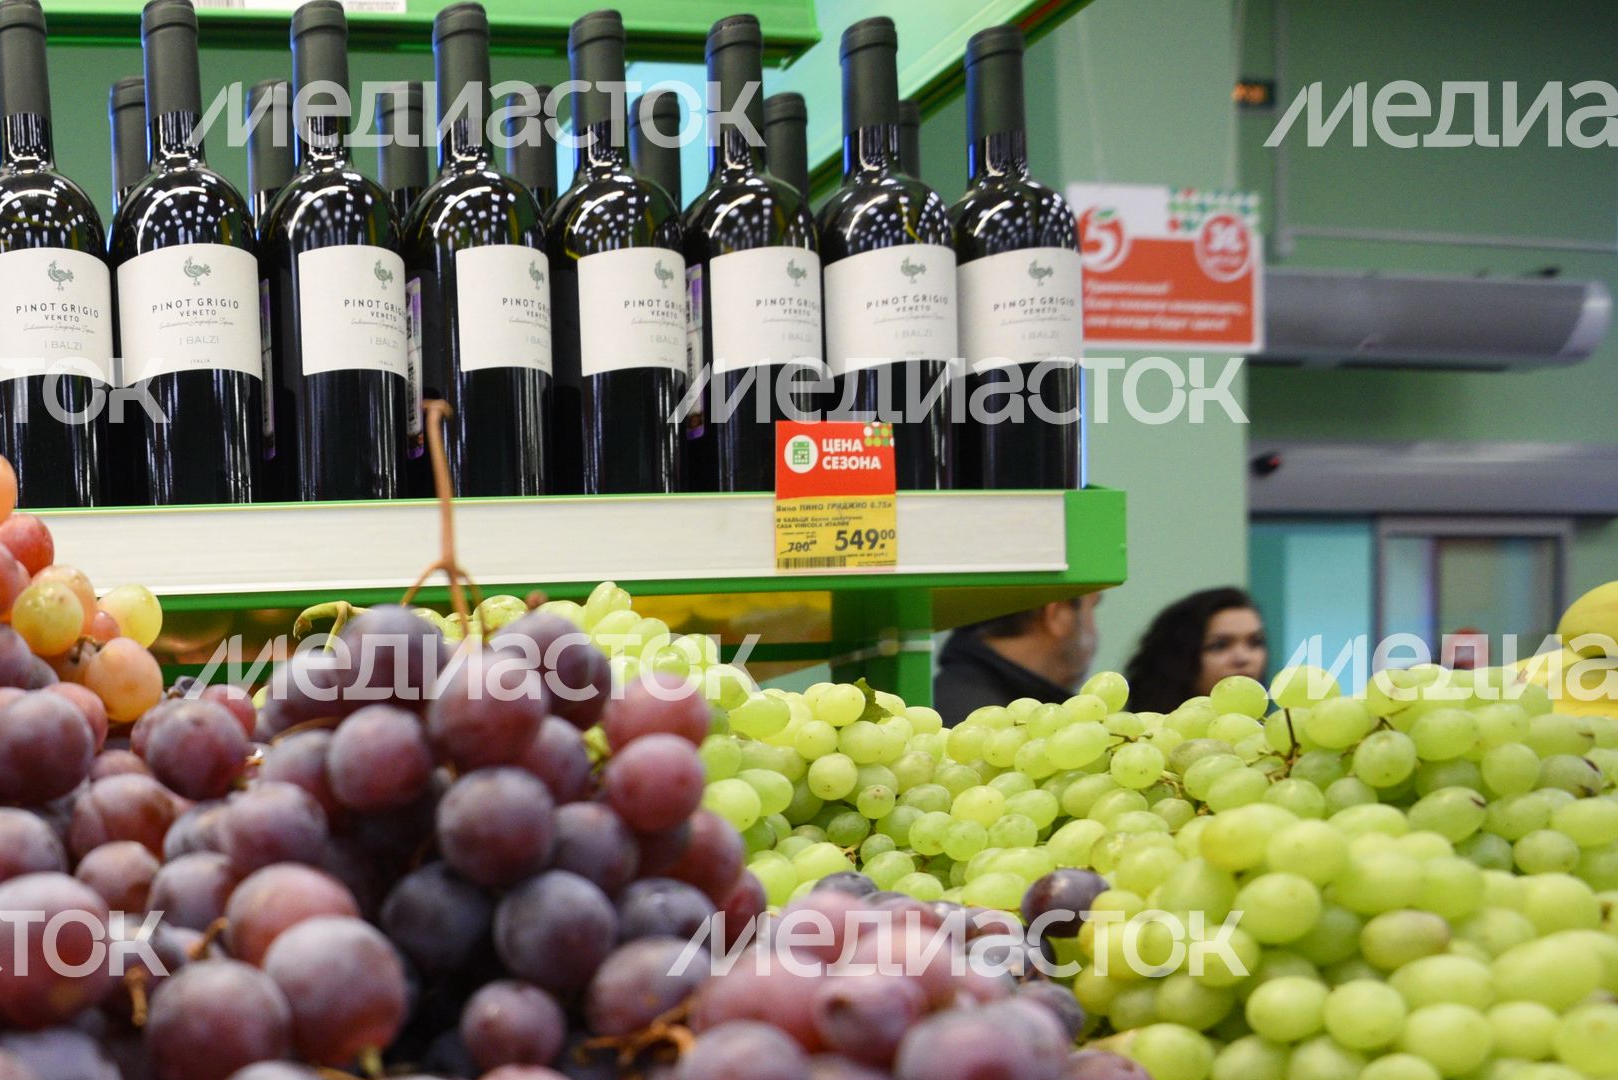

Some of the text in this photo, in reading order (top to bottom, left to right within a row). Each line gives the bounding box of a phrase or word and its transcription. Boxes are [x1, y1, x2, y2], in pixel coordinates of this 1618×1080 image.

[152, 297, 239, 313] PINOT GRIGIO
[344, 299, 380, 309] PINOT
[502, 297, 535, 308] PINOT
[623, 298, 661, 309] PINOT
[755, 297, 793, 307] PINOT
[866, 294, 949, 310] PINOT GRIGIO
[993, 297, 1035, 311] PINOT
[16, 302, 99, 319] PINOT GRIGIO
[179, 309, 217, 317] VENETO
[525, 310, 548, 322] VENETO
[650, 310, 678, 320] VENETO
[44, 314, 80, 322] VENETO
[370, 311, 397, 322] VENETO
[51, 340, 82, 351] BALZI
[186, 335, 219, 345] BALZI
[822, 438, 863, 454] ЦЕНА
[822, 456, 881, 470] СЕЗОНА
[799, 502, 824, 511] ПИНО
